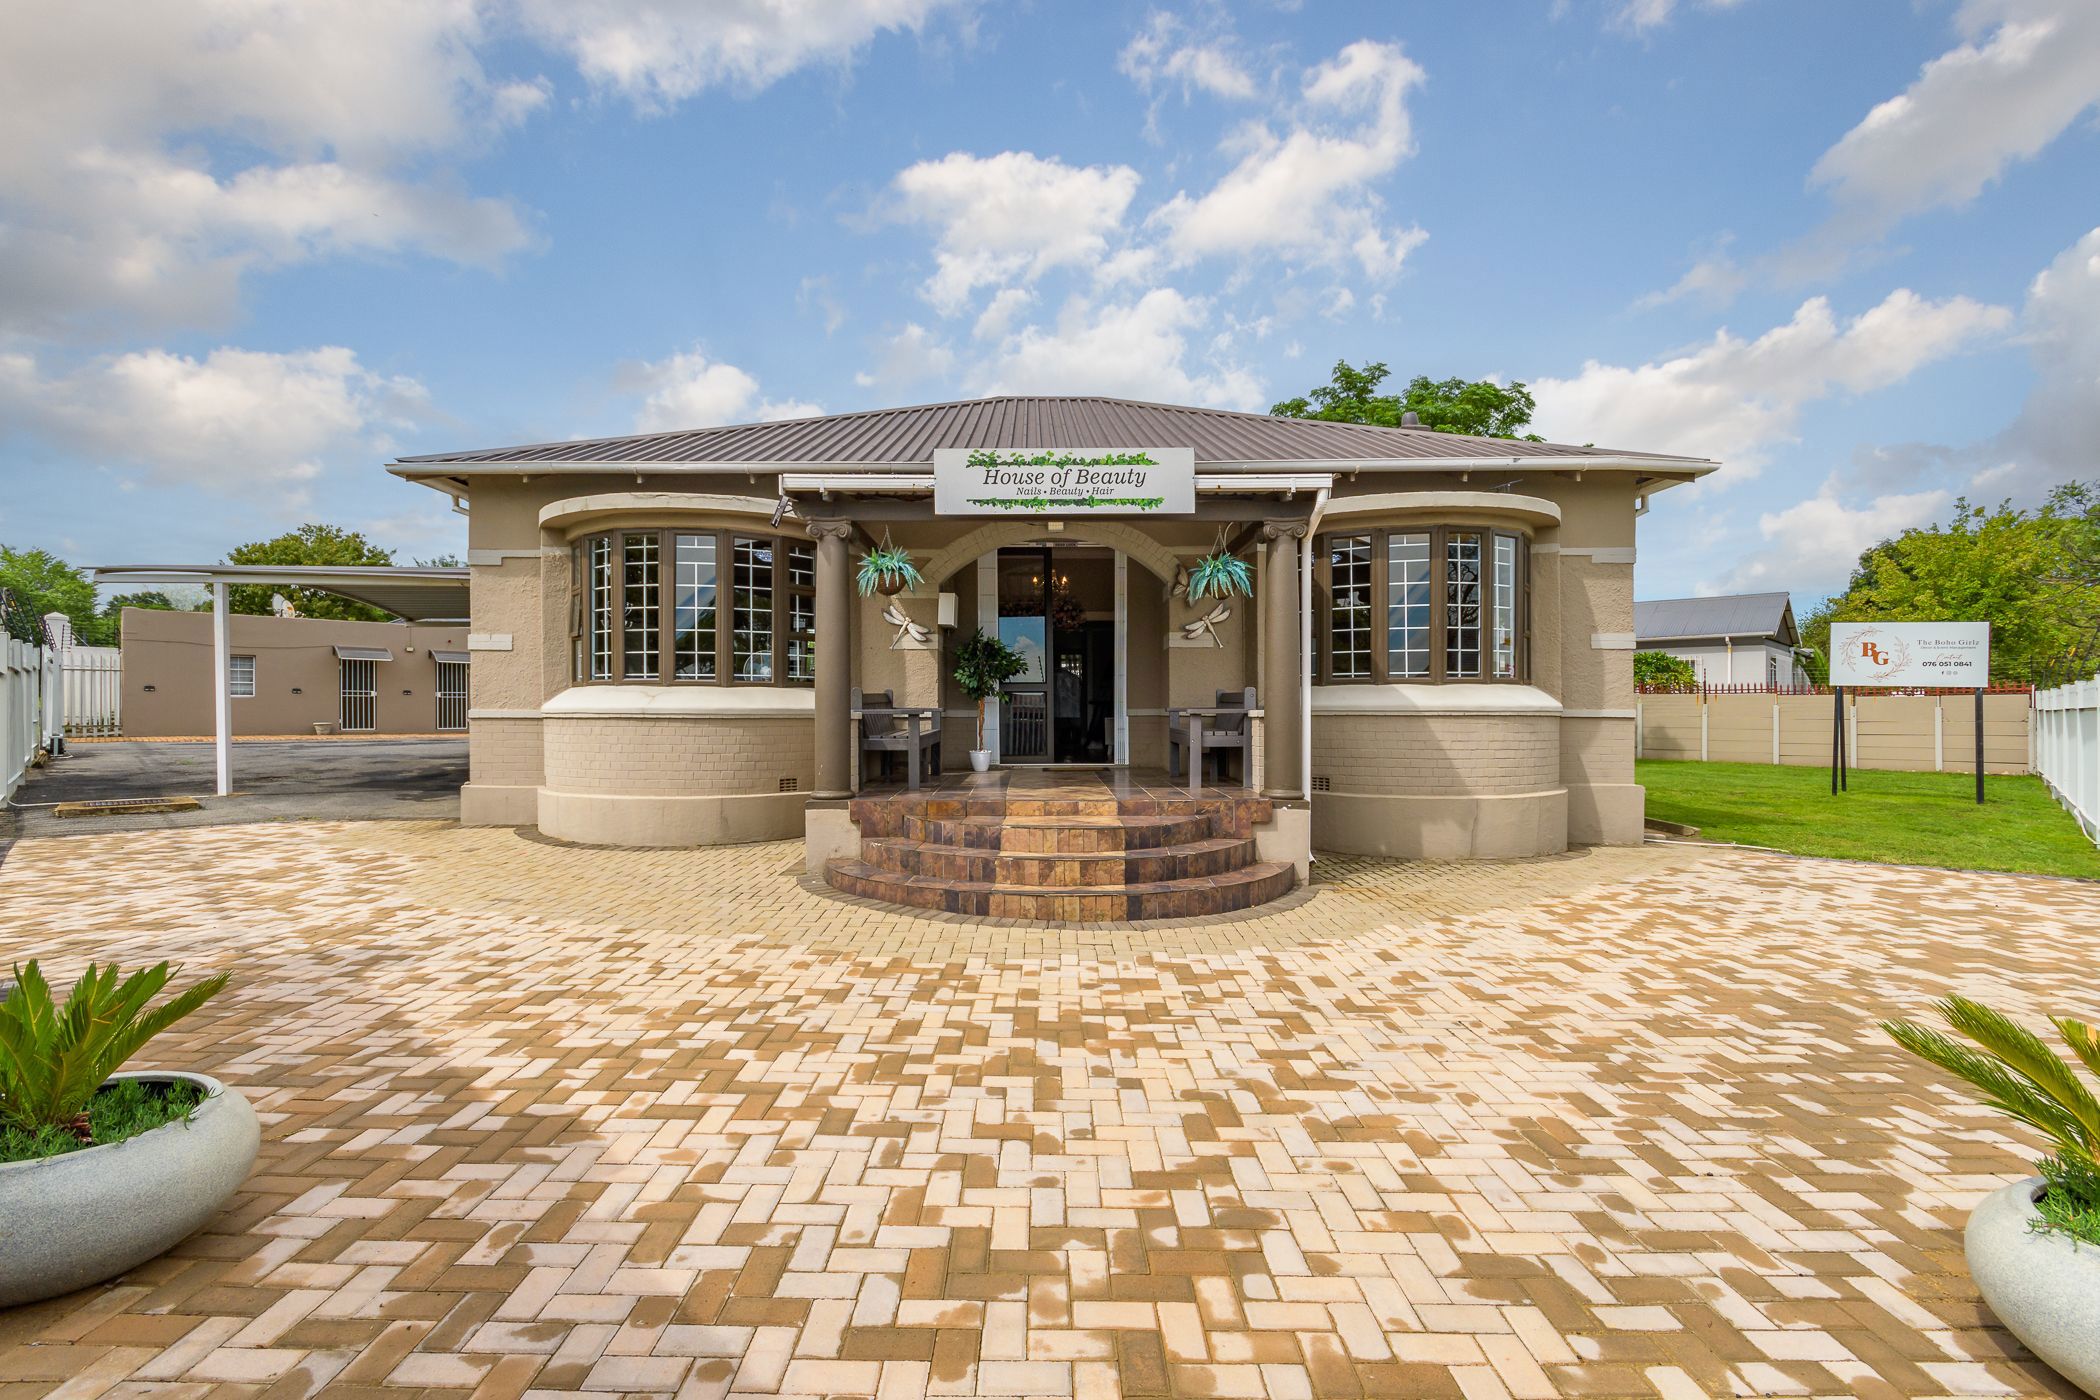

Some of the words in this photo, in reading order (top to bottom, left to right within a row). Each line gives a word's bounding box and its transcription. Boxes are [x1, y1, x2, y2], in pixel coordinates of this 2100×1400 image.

[983, 469, 1044, 485] House
[1051, 469, 1072, 488] of
[1076, 469, 1147, 488] Beauty
[1016, 487, 1042, 496] Nails
[1049, 487, 1084, 497] Beauty
[1092, 487, 1115, 496] Hair
